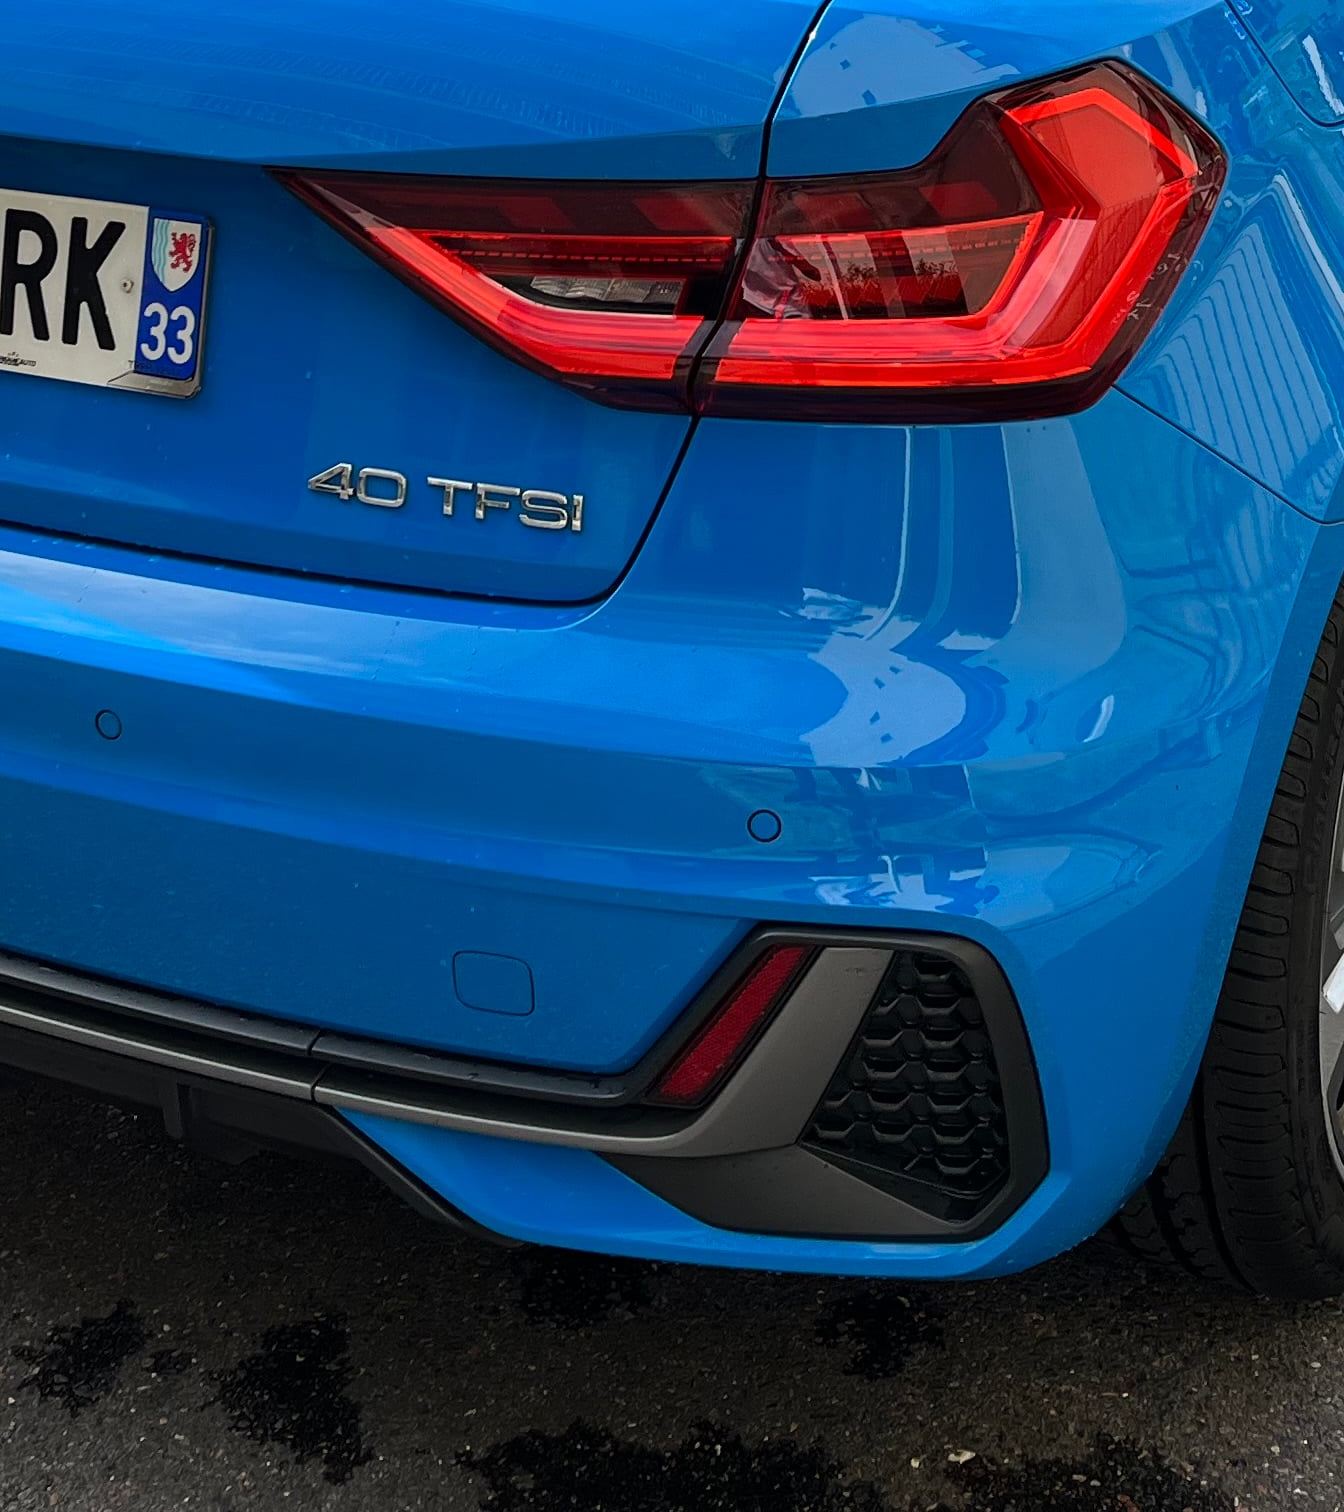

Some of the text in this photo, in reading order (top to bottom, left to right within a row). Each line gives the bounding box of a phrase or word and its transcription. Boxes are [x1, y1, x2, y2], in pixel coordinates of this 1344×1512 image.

[140, 302, 196, 364] 33
[308, 462, 584, 531] 40 TFSI
